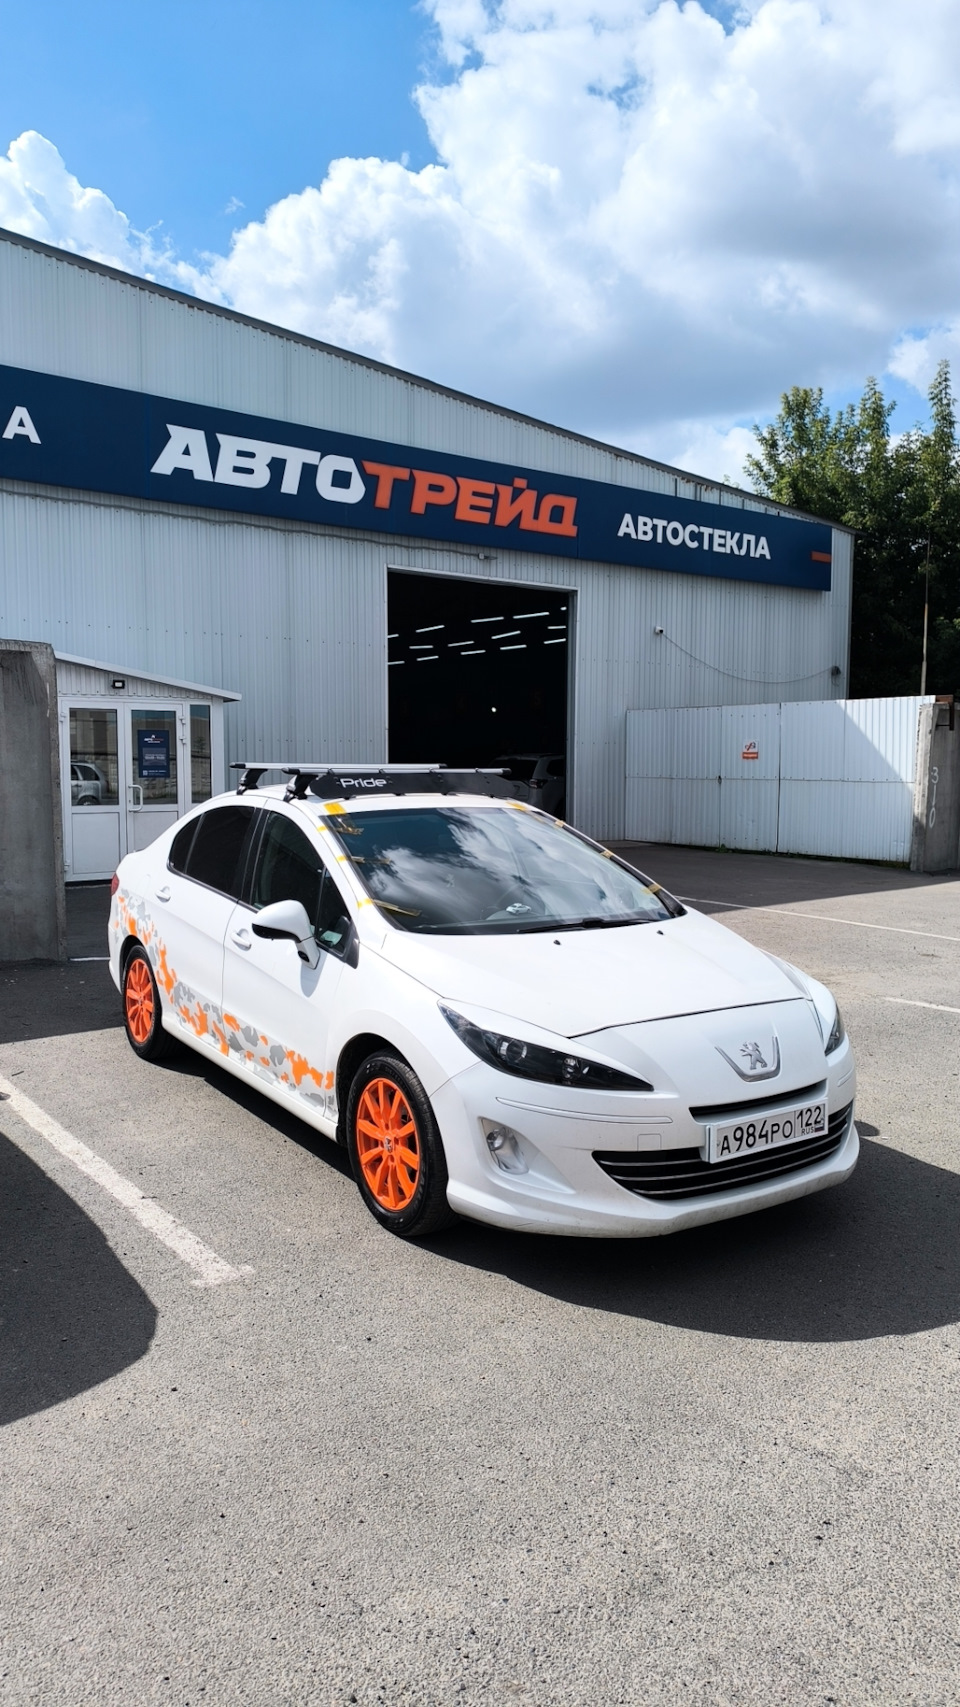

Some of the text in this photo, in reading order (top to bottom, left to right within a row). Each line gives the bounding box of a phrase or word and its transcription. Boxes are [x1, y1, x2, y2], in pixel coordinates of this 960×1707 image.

[150, 423, 578, 538] АВТОТРЕЙД
[617, 512, 771, 560] АВТОСТЕКЛА
[340, 777, 387, 788] Pride
[797, 1106, 821, 1128] 122
[801, 1126, 815, 1136] RUS
